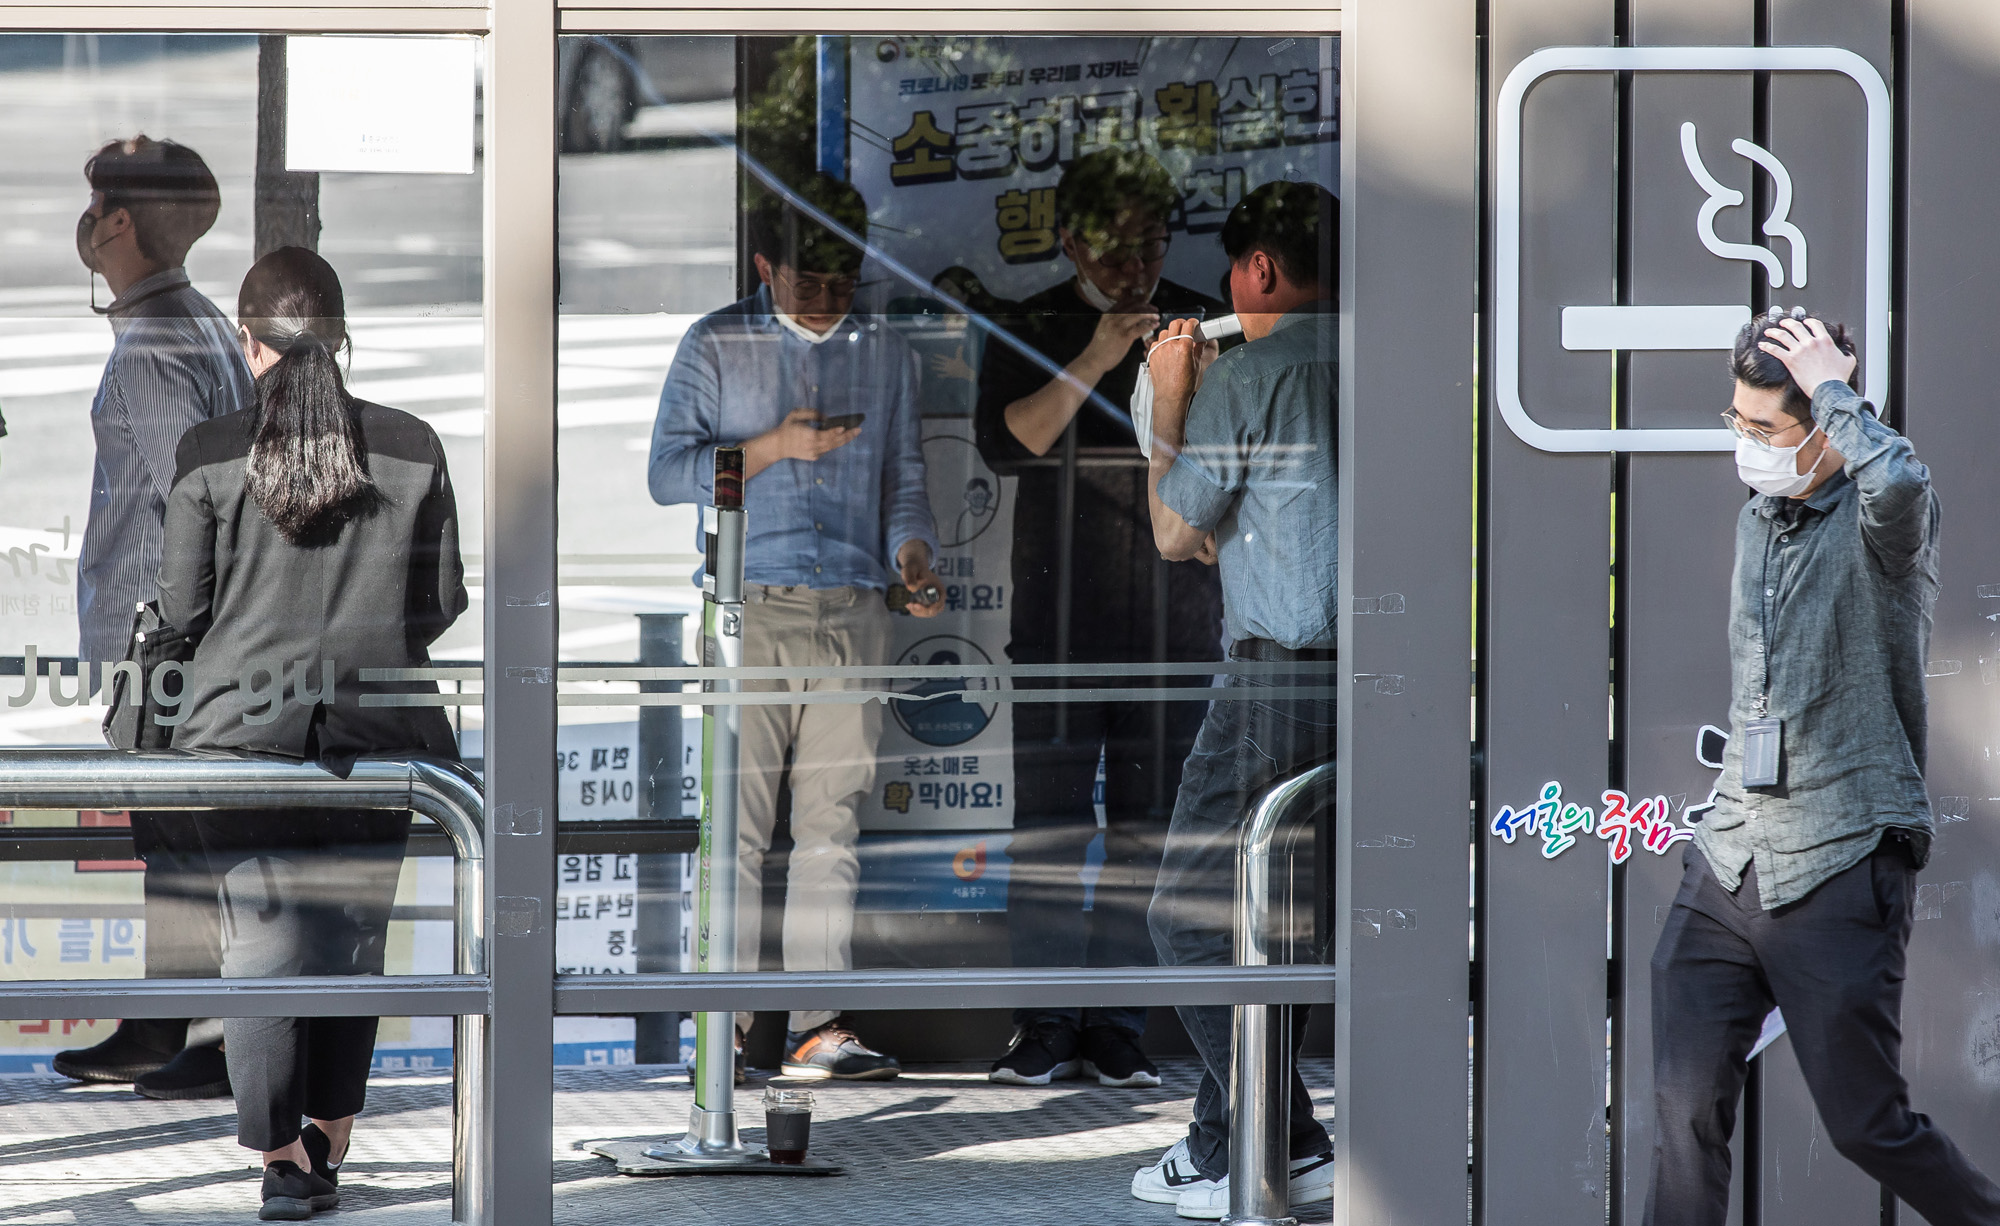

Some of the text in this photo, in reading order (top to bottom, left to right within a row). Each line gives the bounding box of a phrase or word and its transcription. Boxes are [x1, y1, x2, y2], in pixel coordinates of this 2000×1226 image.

[1028, 64, 1083, 87] 우리를
[1085, 59, 1140, 79] 지키는
[997, 185, 1061, 265] 행
[933, 556, 975, 578] 리를
[944, 584, 1004, 611] 워요!
[8, 644, 336, 727] Jung-gu
[903, 755, 980, 776] 옷소매로
[918, 781, 1003, 810] 막아요!
[1492, 782, 1695, 862] 서울의 중심
